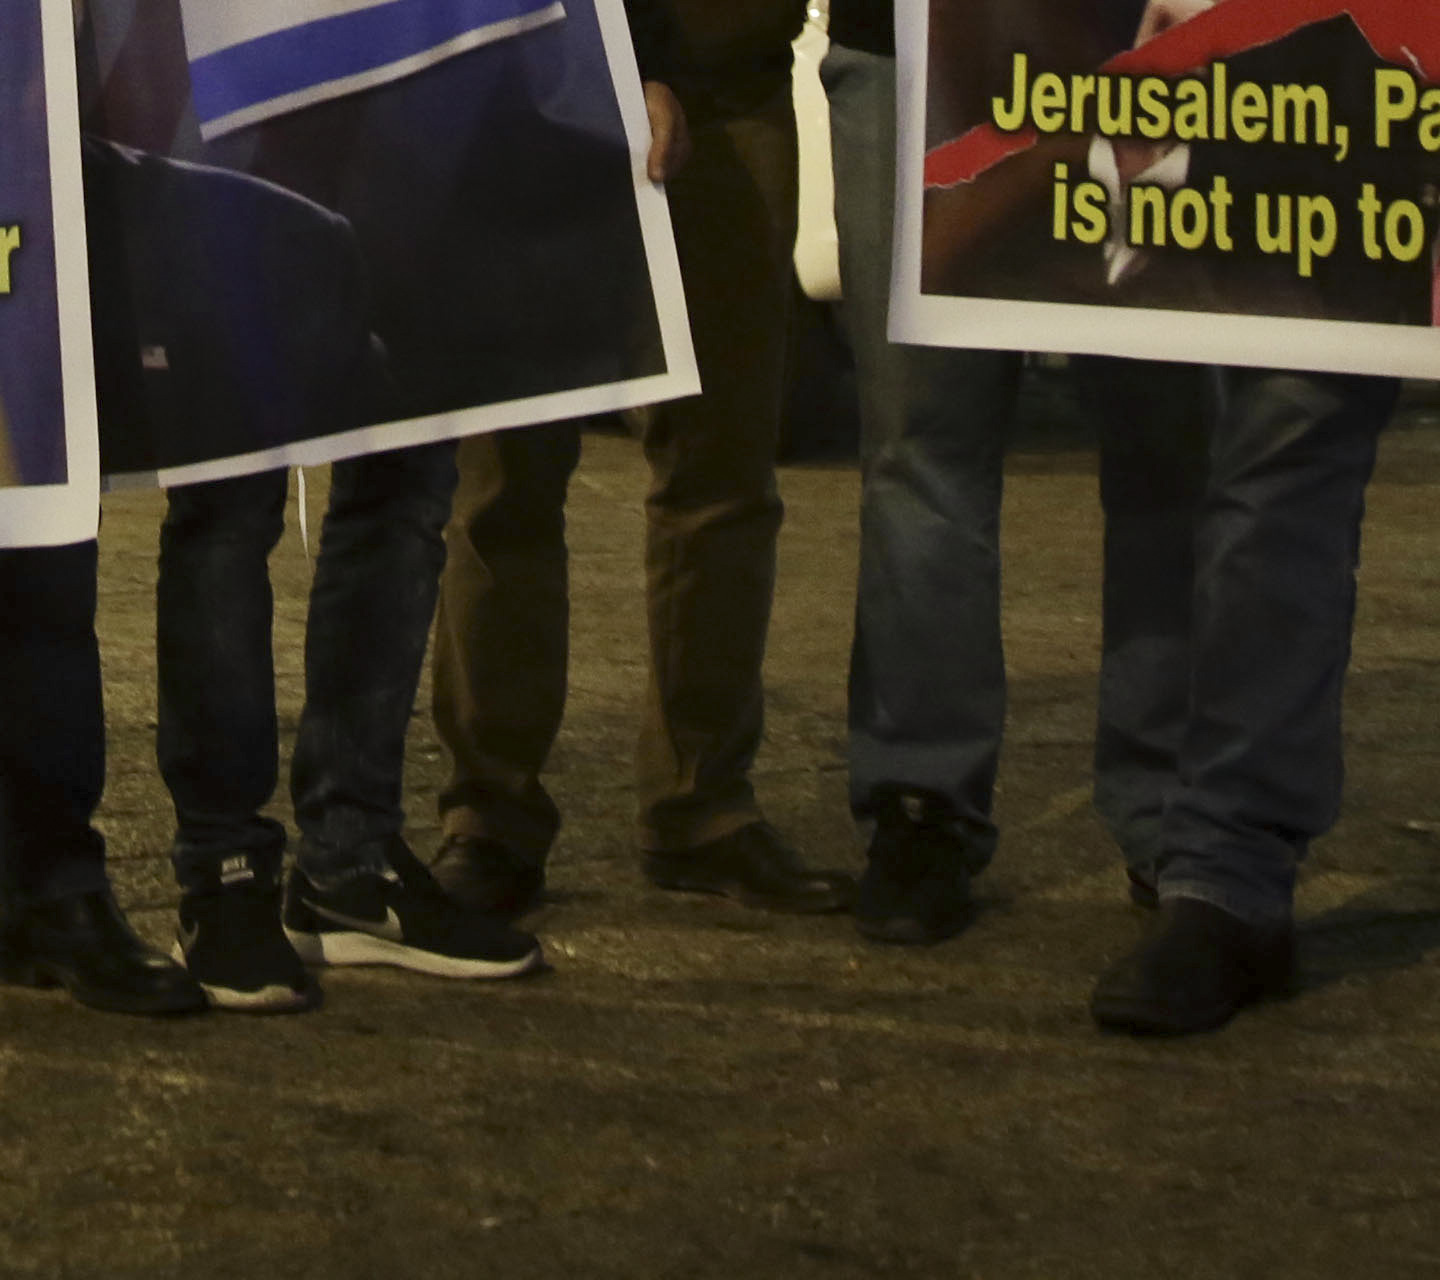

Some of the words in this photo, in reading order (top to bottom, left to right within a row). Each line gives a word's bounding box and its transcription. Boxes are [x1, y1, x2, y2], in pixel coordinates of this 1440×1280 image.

[992, 52, 1349, 162] Jerusalem,
[1052, 162, 1107, 245] is
[1129, 175, 1233, 252] not
[1255, 192, 1338, 278] up
[1357, 183, 1424, 262] to
